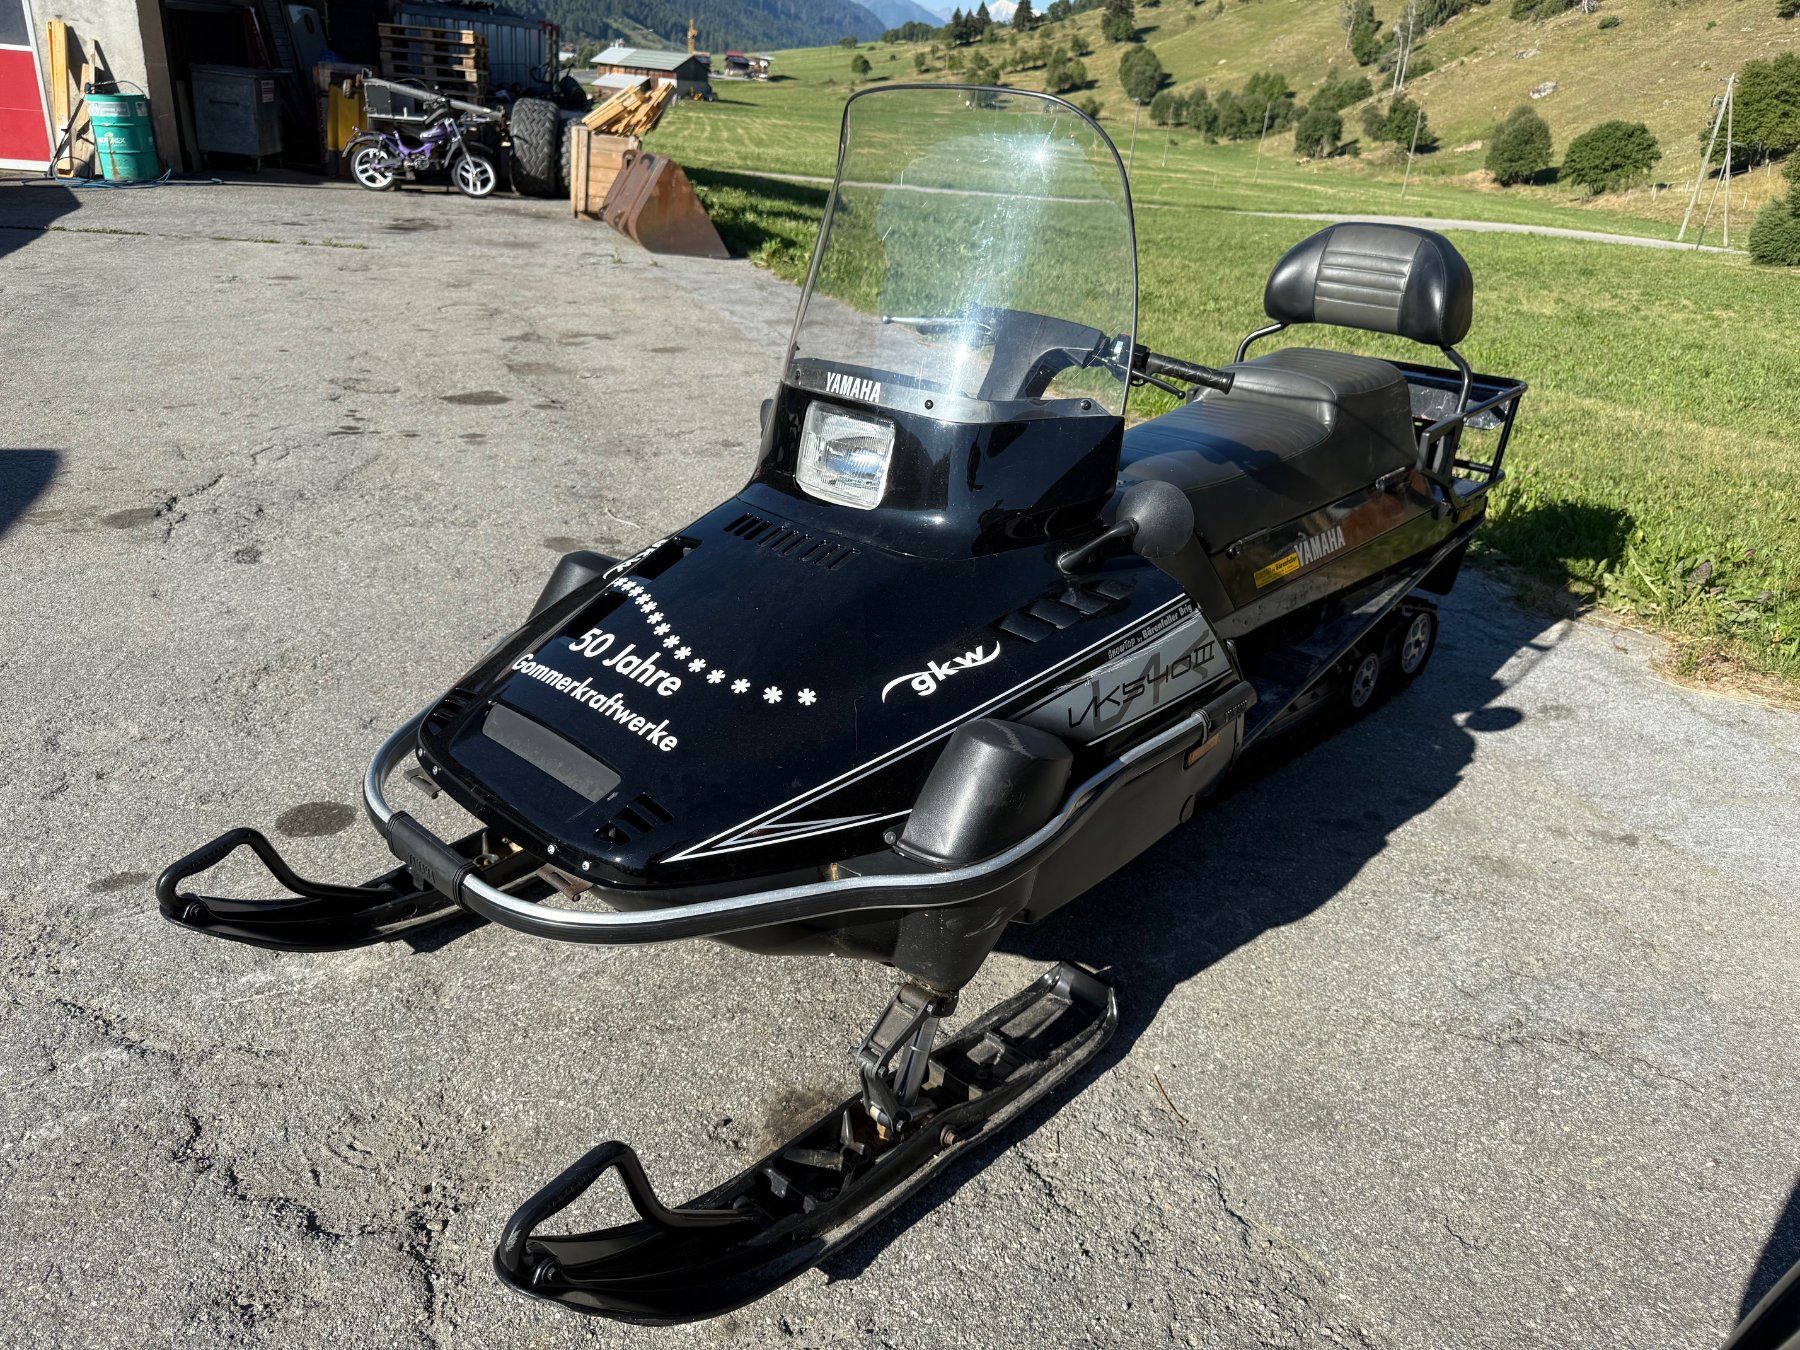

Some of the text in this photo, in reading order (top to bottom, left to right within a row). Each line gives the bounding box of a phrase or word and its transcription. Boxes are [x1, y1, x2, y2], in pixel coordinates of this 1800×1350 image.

[826, 371, 881, 402] YAMAHA
[1294, 526, 1346, 567] YAMAHA
[1142, 613, 1179, 638] Bärenfaller
[1179, 603, 1193, 617] Brig
[569, 628, 681, 697] 50 Jahre
[908, 644, 986, 698] gkw
[511, 653, 678, 752] Gommerkraftwerke
